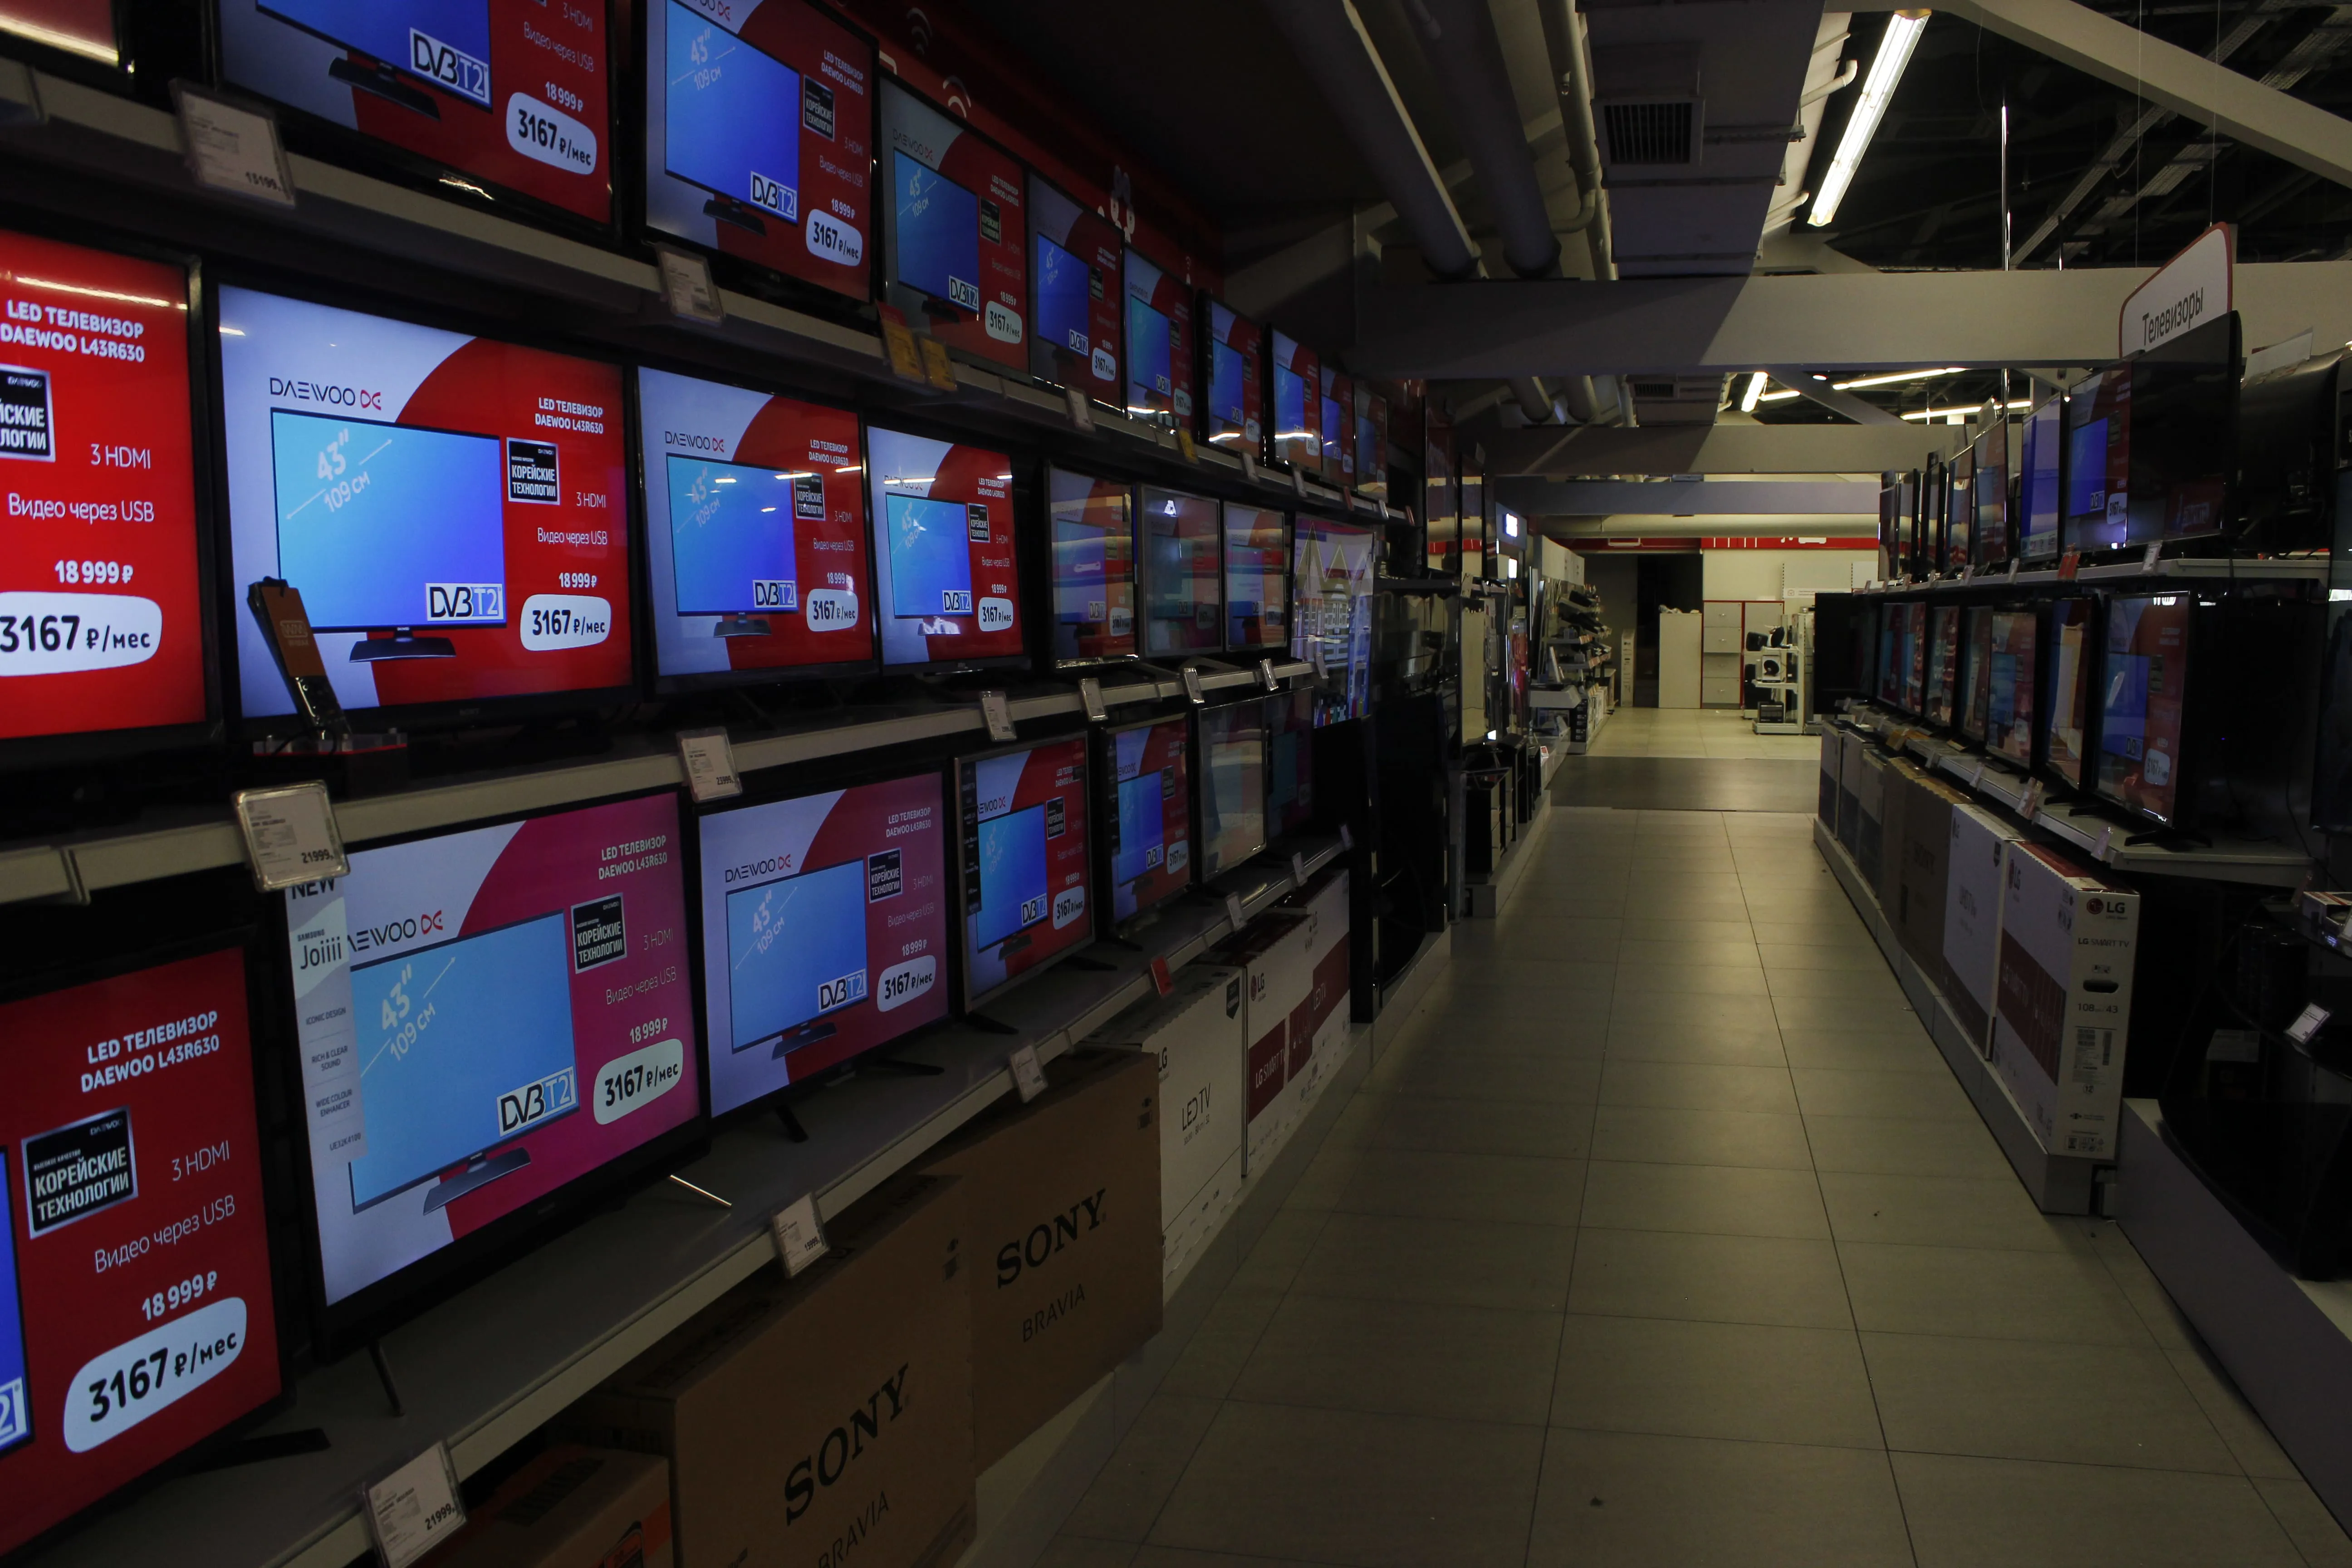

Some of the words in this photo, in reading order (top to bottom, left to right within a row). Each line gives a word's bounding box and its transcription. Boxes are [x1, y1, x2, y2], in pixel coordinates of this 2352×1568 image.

[563, 1, 568, 20] 3
[570, 6, 592, 34] HDMI
[524, 20, 551, 50] Видео
[553, 40, 575, 64] через
[577, 50, 593, 73] USB
[8, 299, 43, 323] LED
[45, 306, 144, 339] ТЕЛЕВИЗОР
[2142, 287, 2204, 345] Телевизоры
[0, 322, 77, 352] DAEWOO
[80, 336, 145, 363] L43R630
[270, 377, 355, 406] DAEWOO
[539, 397, 555, 412] LED
[556, 400, 603, 418] ТЕЛЕВИЗОР
[534, 412, 571, 430] DAEWOO
[572, 418, 603, 434] L43R630
[89, 443, 101, 465] 3
[105, 445, 152, 469] HDMI
[511, 464, 555, 482] КОРЕЙСКИЕ
[512, 481, 556, 497] ТЕХНОЛОГИИ
[576, 491, 581, 506] 3
[583, 492, 606, 508] HDMI
[8, 493, 66, 519] Видео
[69, 502, 118, 524] через
[121, 500, 155, 522] USB
[537, 527, 564, 544] Видео
[566, 533, 589, 547] через
[591, 530, 607, 544] USB
[0, 615, 80, 652] 3167
[532, 610, 570, 635] 3167
[886, 823, 909, 838] DAEWOO
[910, 818, 931, 832] L43R630
[888, 813, 899, 825] LED
[900, 806, 931, 822] ТЕЛЕВИЗОР
[601, 845, 618, 862] LED
[618, 833, 666, 857] ТЕЛЕВИЗОР
[598, 858, 635, 881] DAEWOO
[636, 851, 667, 871] L43R630
[725, 859, 775, 883] DAEWOO
[871, 867, 899, 885] КОРЕЙСКИЕ
[872, 879, 900, 897] ТЕХНОЛОГИИ
[2107, 902, 2125, 914] LG
[577, 920, 622, 948] КОРЕЙСКИЕ
[643, 934, 649, 951] 3
[651, 926, 673, 948] HDMI
[2091, 938, 2116, 947] SMART
[578, 937, 623, 964] ТЕХНОЛОГИИ
[606, 985, 634, 1005] Видео
[634, 975, 658, 995] через
[659, 965, 676, 985] USB
[326, 1007, 346, 1020] DESIGN
[87, 1037, 122, 1066] LED
[122, 1009, 219, 1054] ТЕЛЕВИЗОР
[331, 1045, 348, 1057] CLEAR
[79, 1052, 155, 1094] DAEWOO
[157, 1033, 220, 1069] L43R630
[604, 1064, 642, 1107] 3167
[1199, 1083, 1210, 1114] TV
[34, 1145, 127, 1200] КОРЕЙСКИЕ
[170, 1156, 182, 1182] 3
[186, 1138, 230, 1176] HDMI
[37, 1170, 130, 1222] ТЕХНОЛОГИИ
[93, 1235, 151, 1274] Видео
[152, 1212, 200, 1246] через
[202, 1192, 235, 1226] USB
[998, 1189, 1105, 1289] SONY
[1022, 1284, 1085, 1342] BRAVIA
[89, 1346, 167, 1424] 3167
[784, 1363, 908, 1526] SONY
